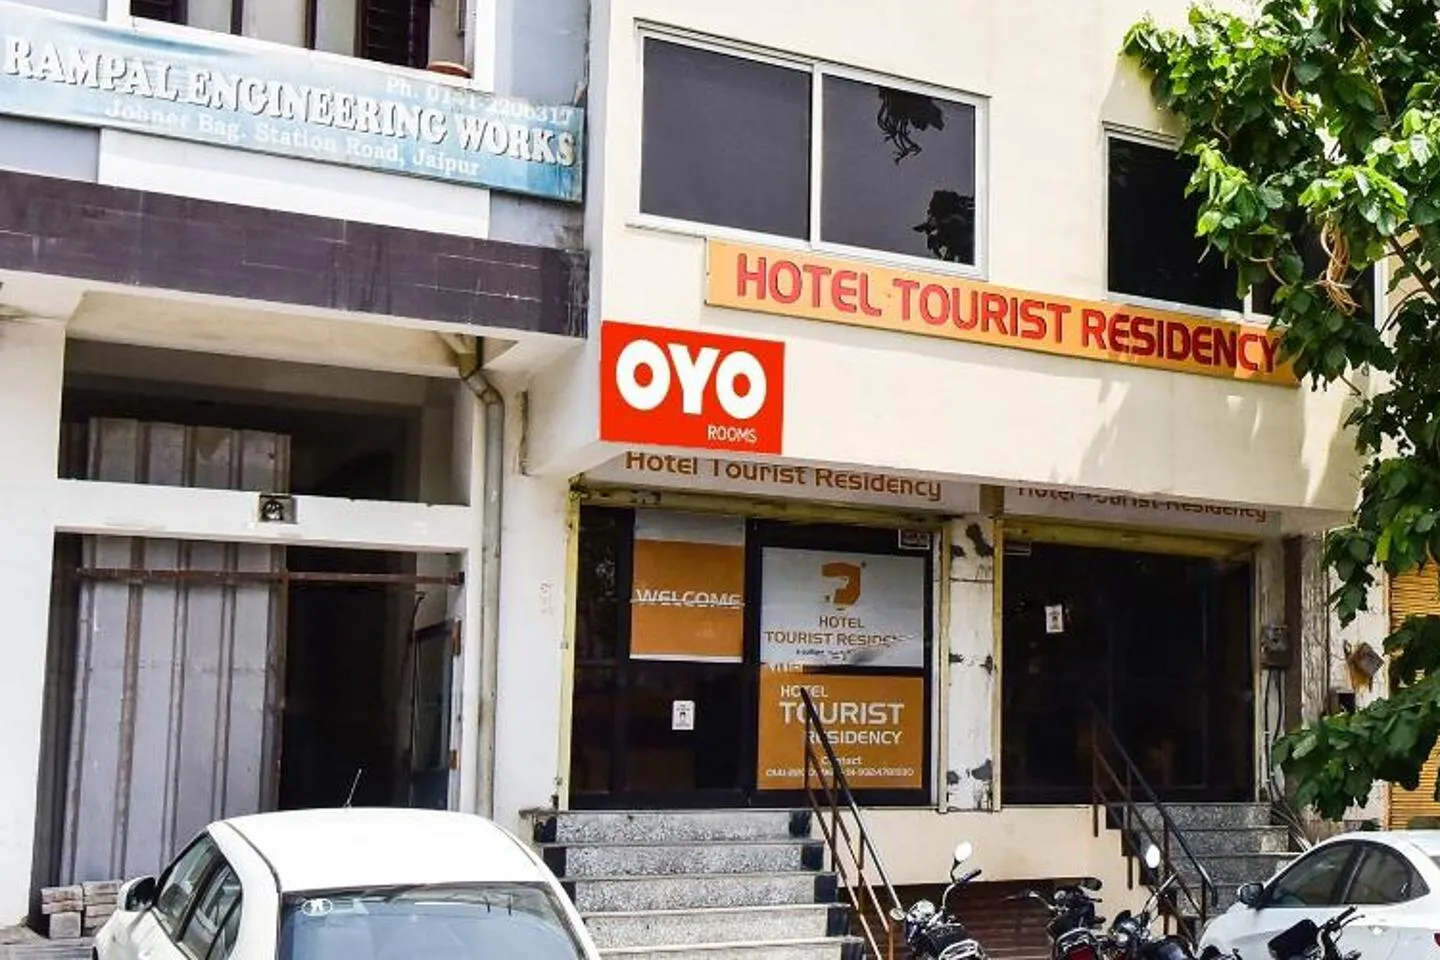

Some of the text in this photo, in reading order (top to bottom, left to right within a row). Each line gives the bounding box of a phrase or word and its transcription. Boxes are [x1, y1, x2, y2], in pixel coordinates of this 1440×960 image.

[4, 39, 576, 167] RAMPAL ENGINEERING WORKS
[254, 123, 337, 151] Station
[346, 137, 405, 168] Road,
[413, 148, 481, 178] Jaipur
[736, 253, 1280, 374] HOTEL TOURIST RESIDENCY
[615, 338, 767, 420] OYO
[707, 424, 757, 444] ROOMS
[625, 450, 943, 502] Hotel Tourist Residency
[635, 589, 742, 609] WELCOME
[764, 630, 907, 649] TOURIST RESIDE
[819, 615, 865, 629] HOTEL
[821, 755, 863, 766] Cntact
